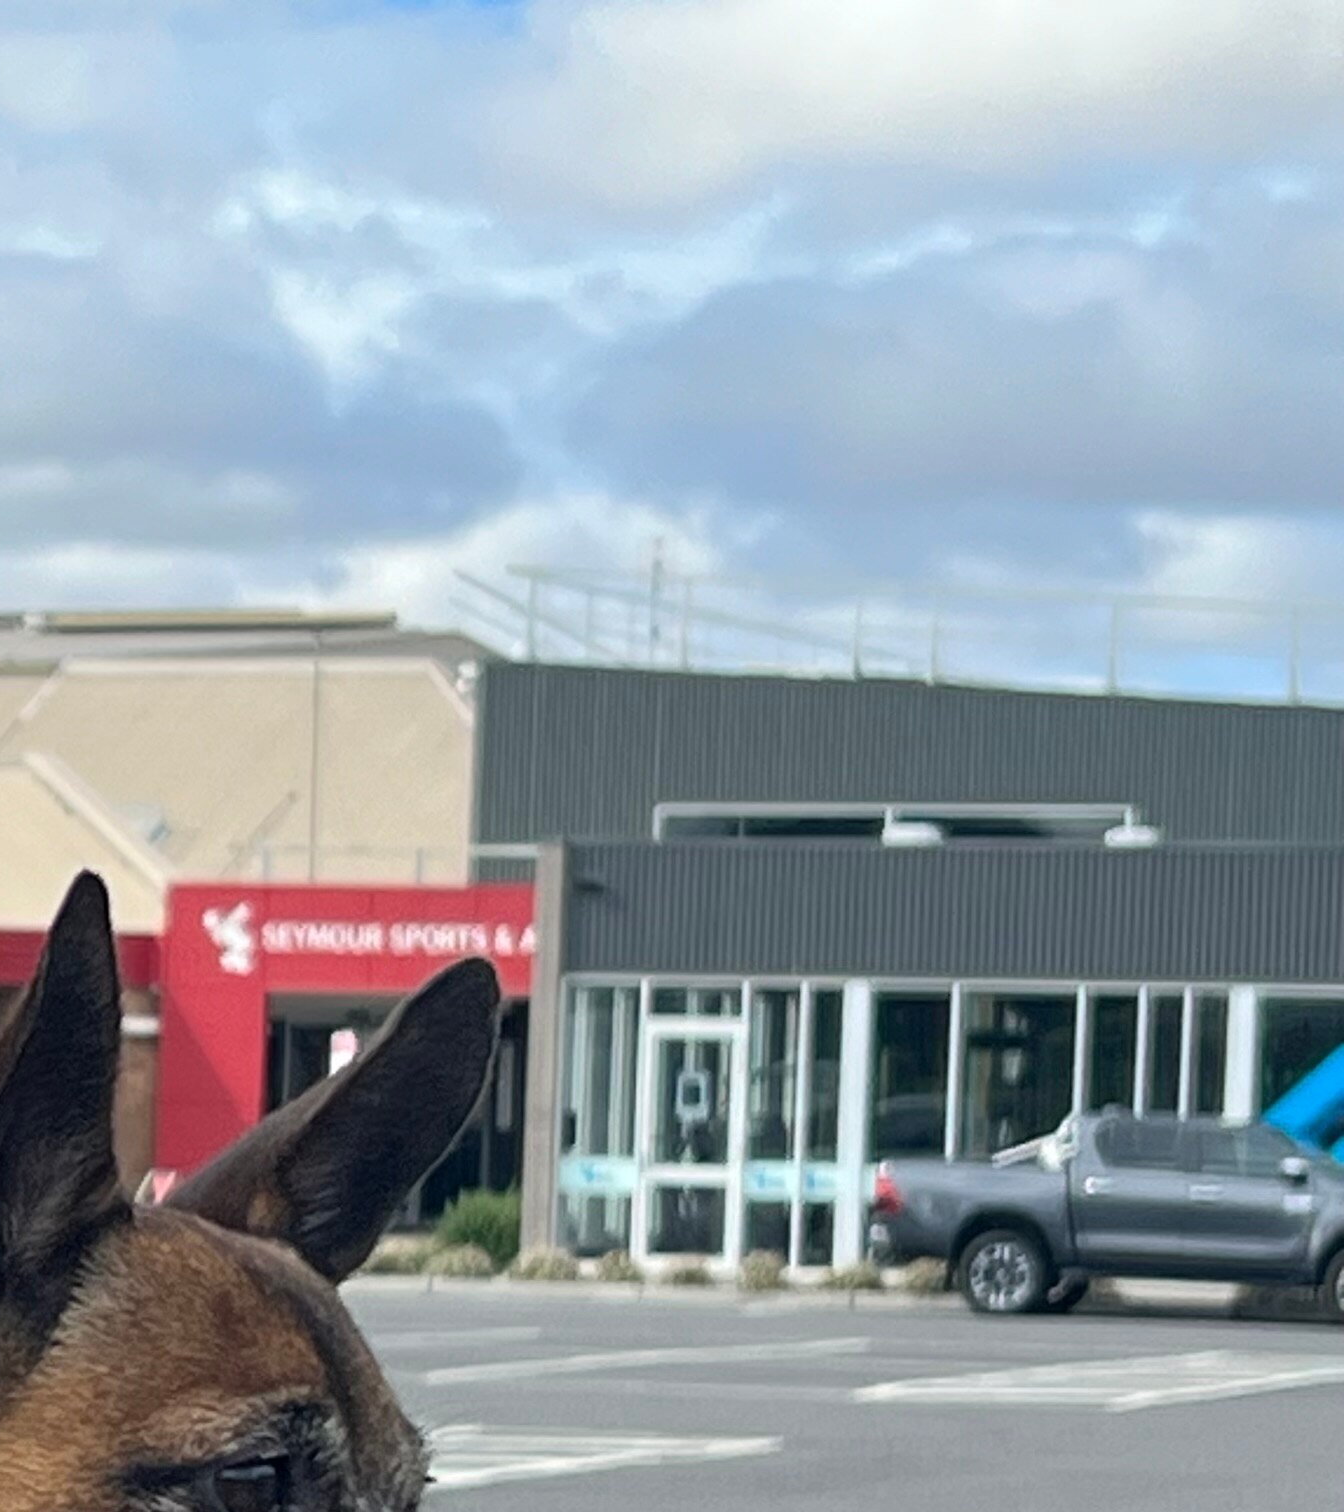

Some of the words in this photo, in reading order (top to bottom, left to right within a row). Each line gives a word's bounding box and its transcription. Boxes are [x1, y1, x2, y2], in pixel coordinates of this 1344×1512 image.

[262, 922, 382, 954] SEYMOUR
[389, 923, 487, 955] SPORTS
[494, 923, 512, 955] &
